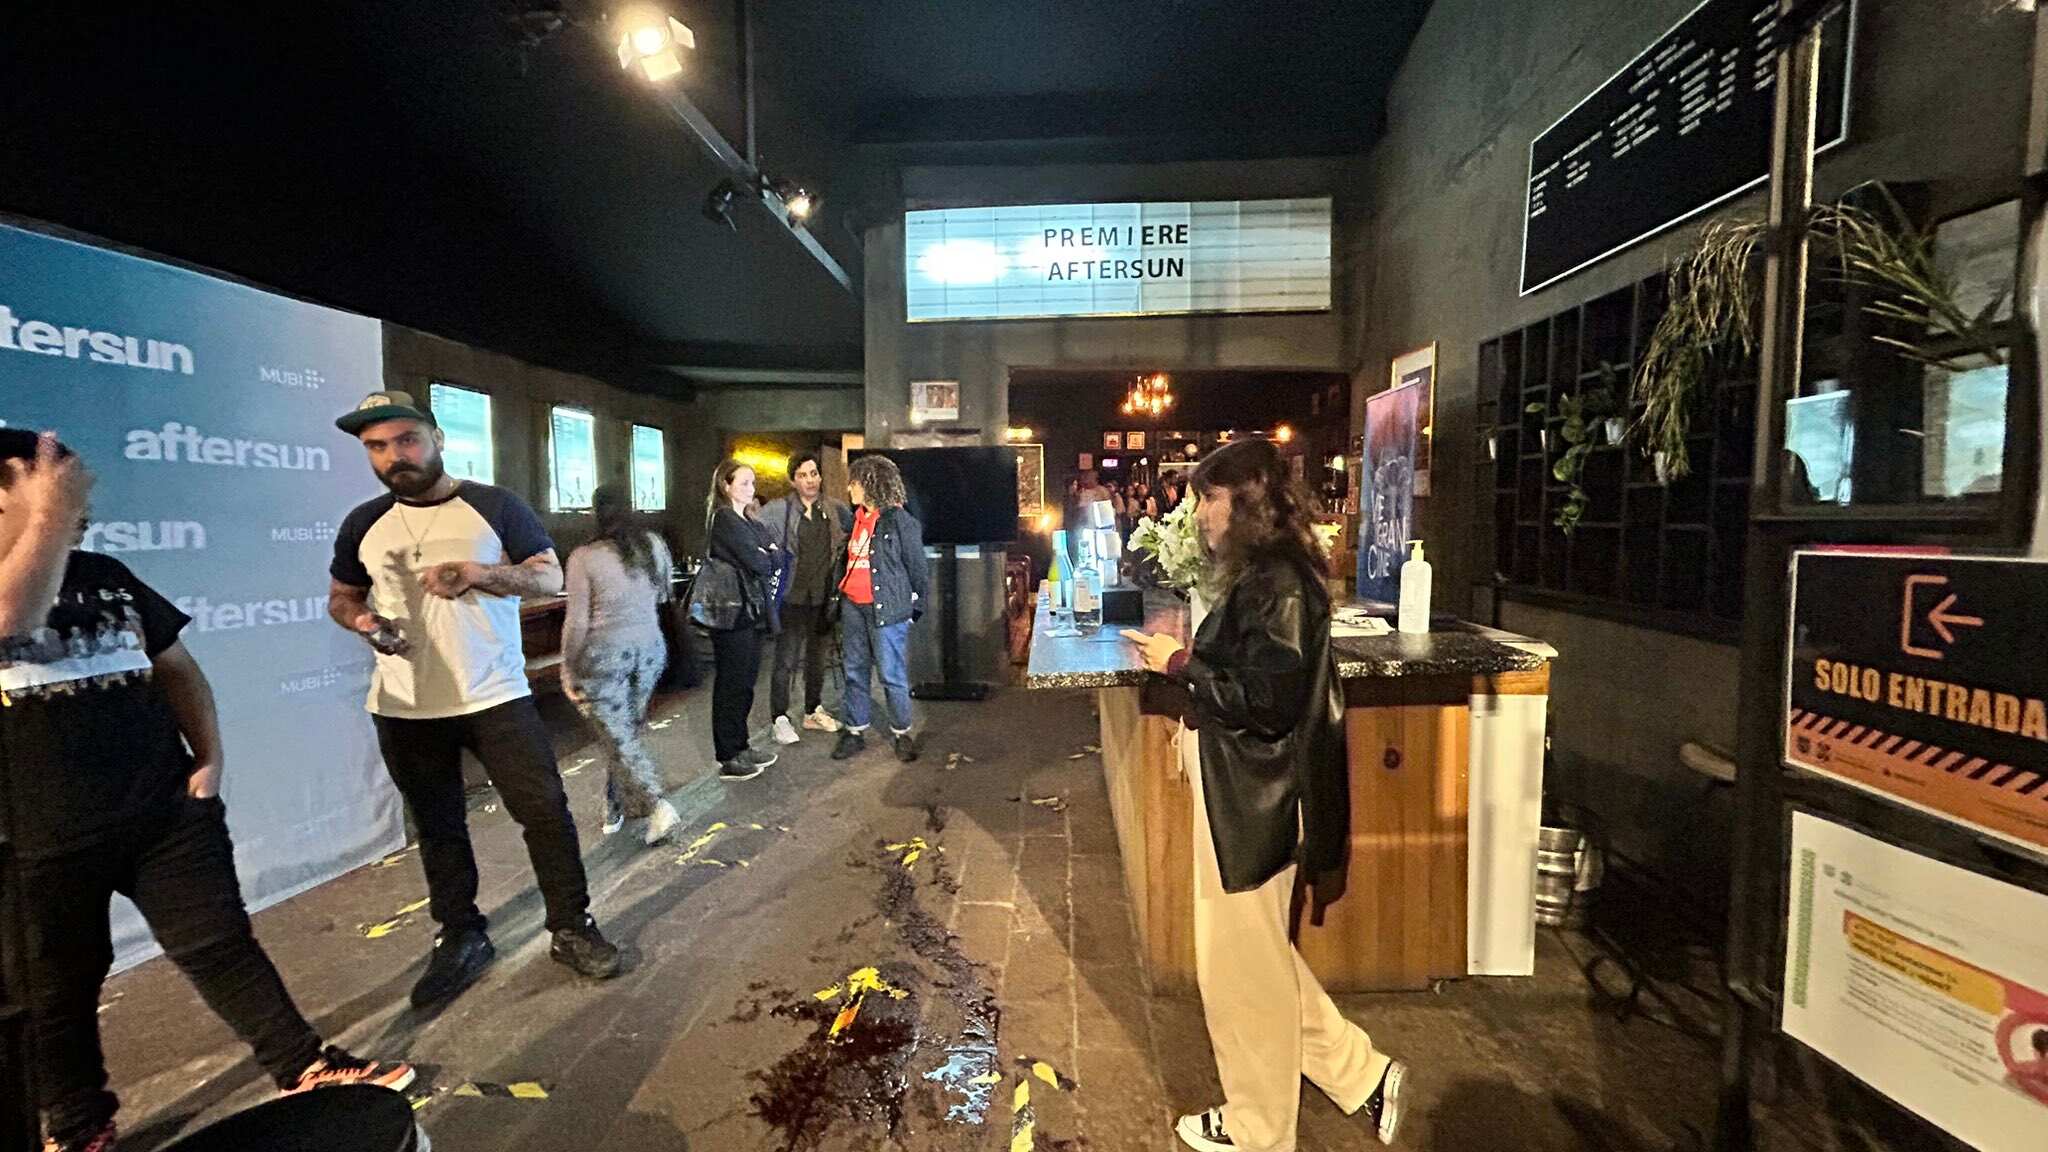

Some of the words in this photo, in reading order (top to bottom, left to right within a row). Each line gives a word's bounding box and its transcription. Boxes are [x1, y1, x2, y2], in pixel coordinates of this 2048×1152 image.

[1044, 224, 1188, 248] PREMIERE
[1048, 258, 1184, 281] AFTERSUN
[0, 304, 194, 376] tersun
[260, 367, 303, 387] MUBI
[124, 421, 330, 471] aftersun
[80, 521, 207, 552] rsun
[271, 527, 313, 541] MUBI
[280, 675, 321, 695] MUBI
[1815, 659, 1881, 702] SOLO
[1888, 673, 2048, 740] ENTRADA
